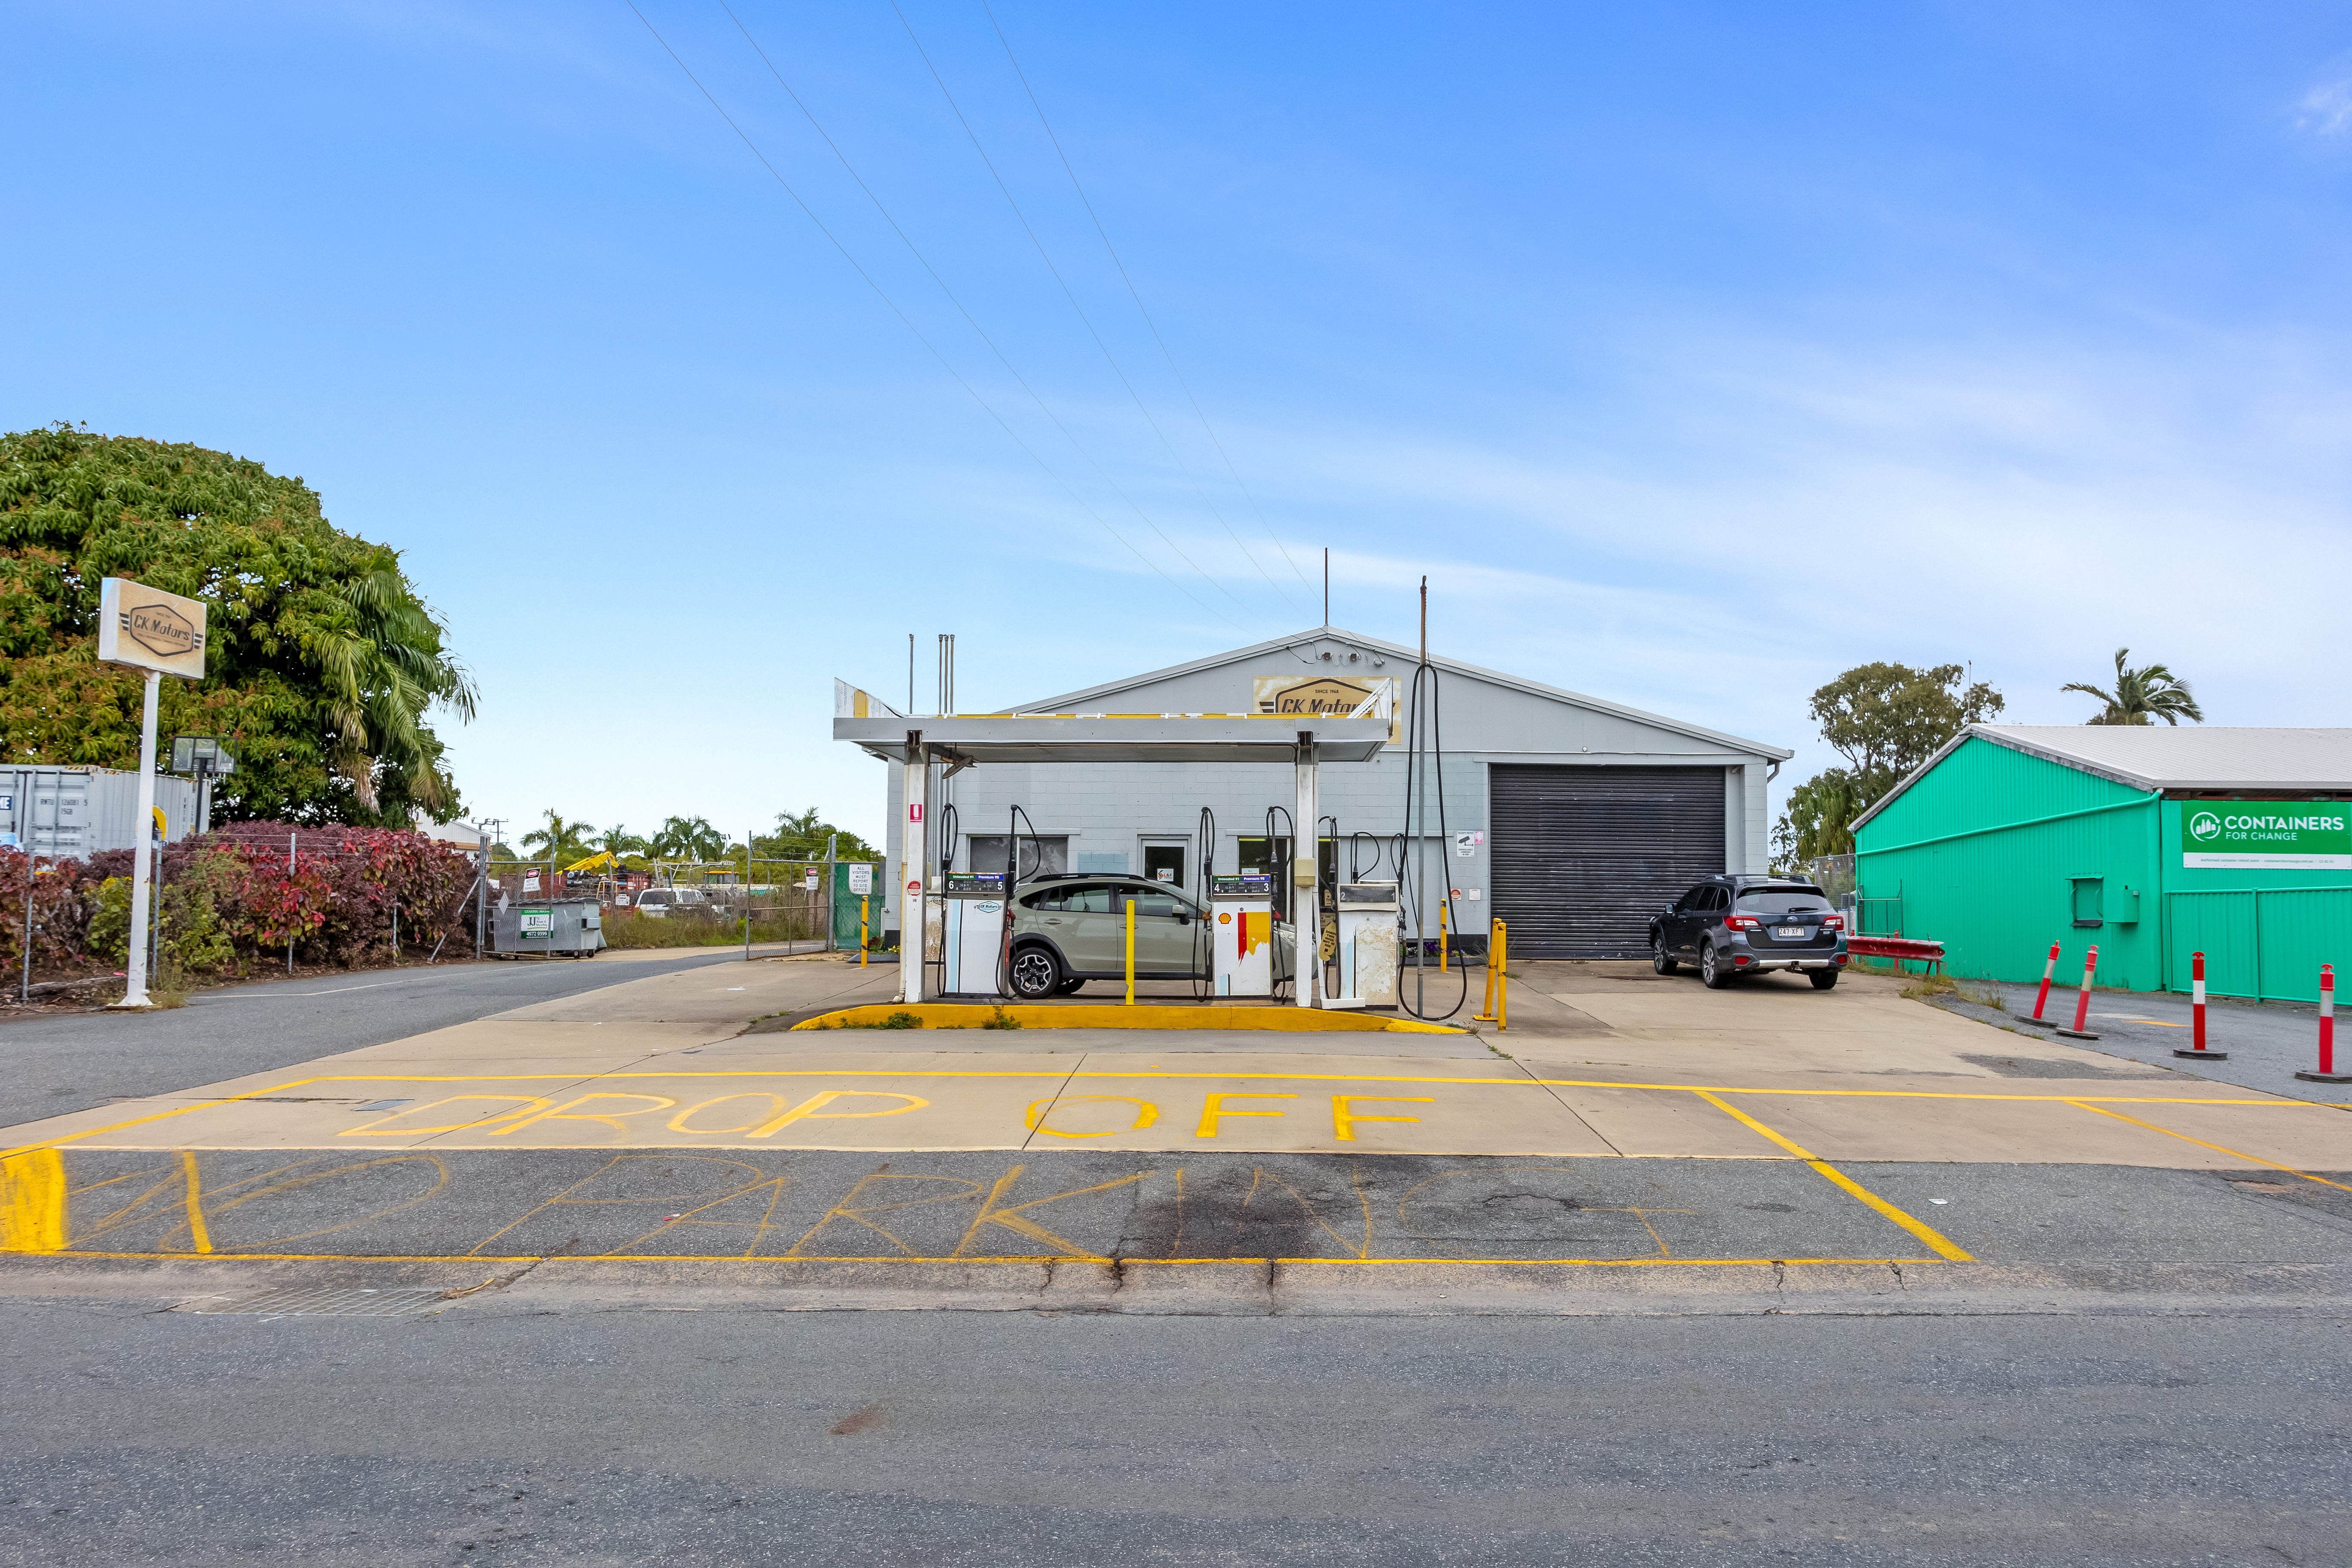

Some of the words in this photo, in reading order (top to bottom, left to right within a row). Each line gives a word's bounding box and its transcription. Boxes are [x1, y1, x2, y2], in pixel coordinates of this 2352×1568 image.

[134, 615, 150, 630] CK
[150, 619, 190, 640] Motors
[1282, 699, 1306, 713] CK
[1308, 699, 1361, 713] Motor
[2224, 815, 2344, 830] CONTAINERS
[2251, 832, 2298, 840] CHANGE
[949, 881, 954, 889] 6
[998, 882, 1003, 890] 5
[1214, 883, 1220, 892] 4
[1264, 883, 1269, 892] 3
[1341, 892, 1345, 900] 2
[1391, 892, 1395, 900] 1
[337, 1090, 930, 1139] DROP
[1025, 1093, 1436, 1141] OFF
